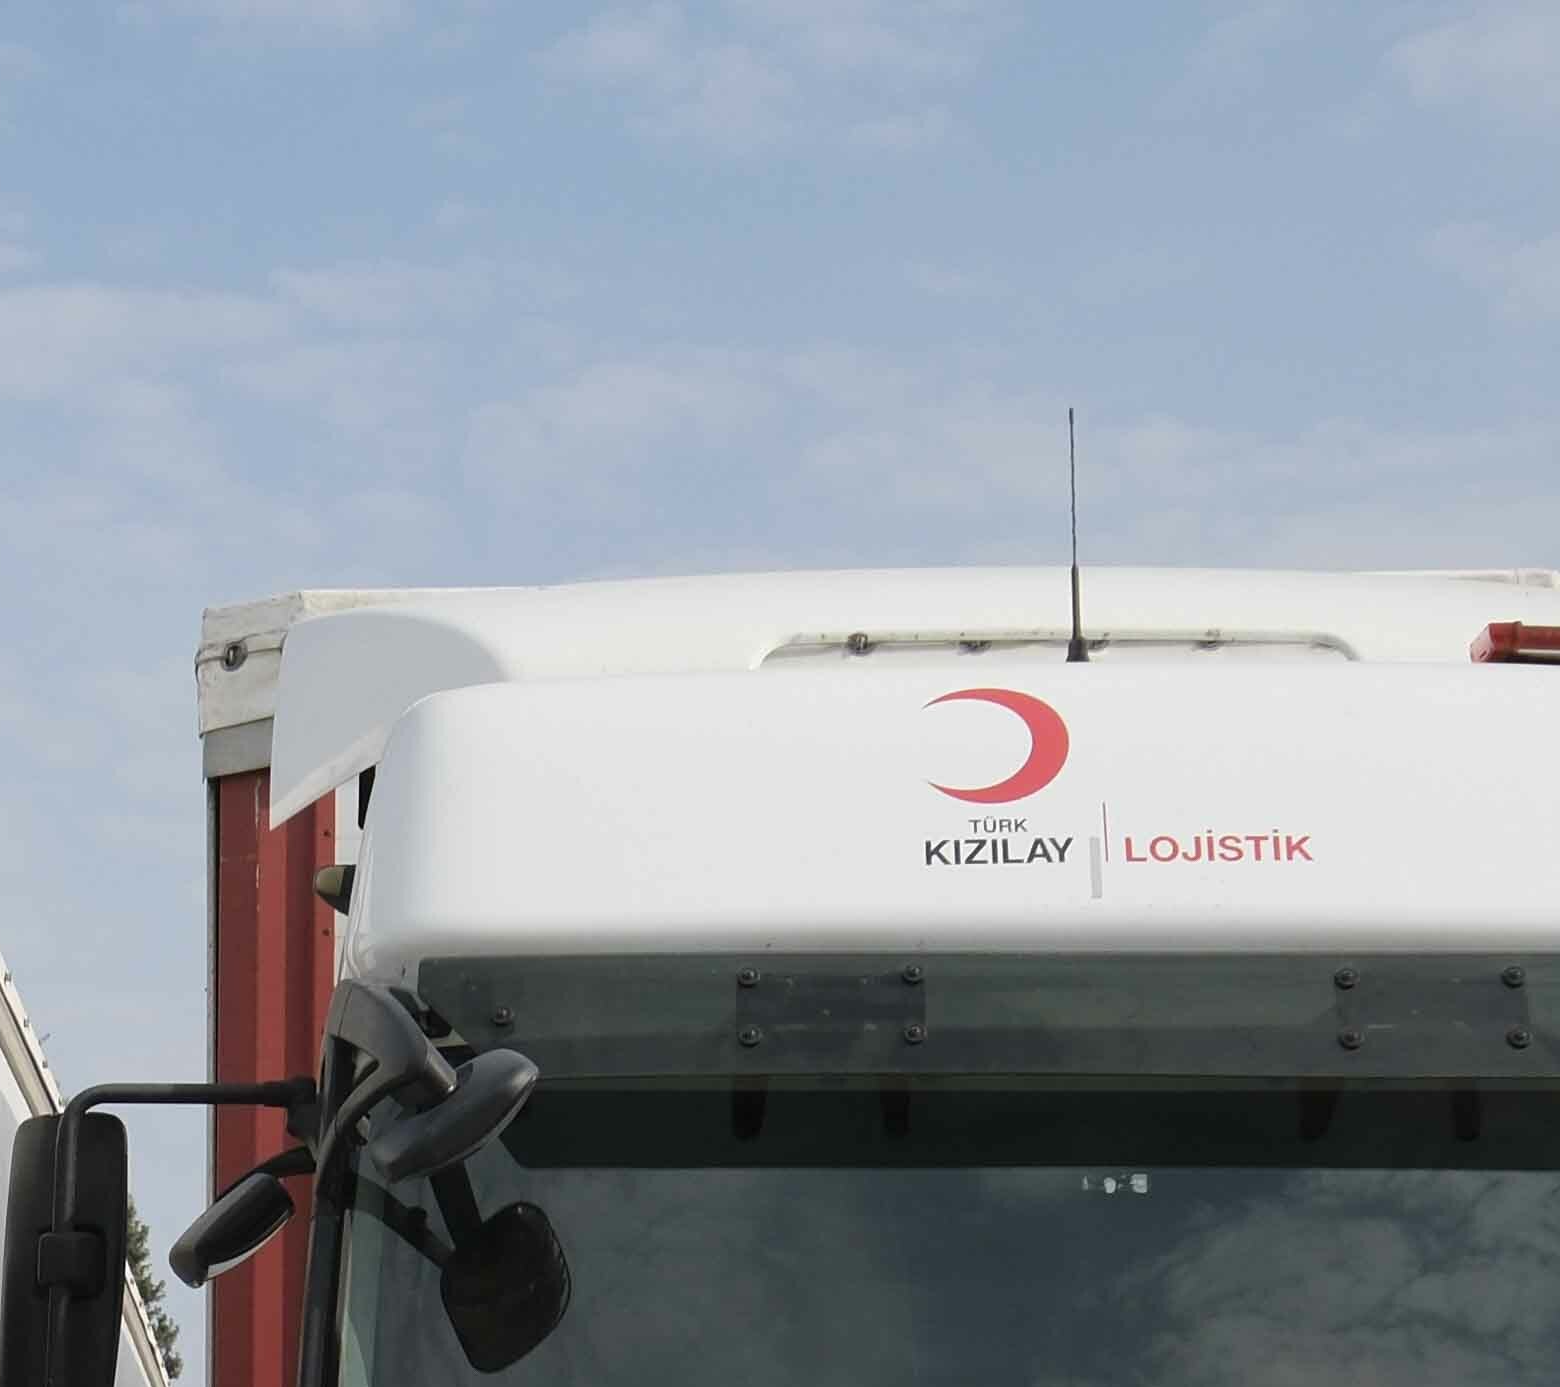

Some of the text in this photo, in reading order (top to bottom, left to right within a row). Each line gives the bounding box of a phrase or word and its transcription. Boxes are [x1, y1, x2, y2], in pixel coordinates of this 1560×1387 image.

[968, 815, 1028, 834] TÜRK
[924, 828, 1313, 867] KIZILAY LOJİSTİK
